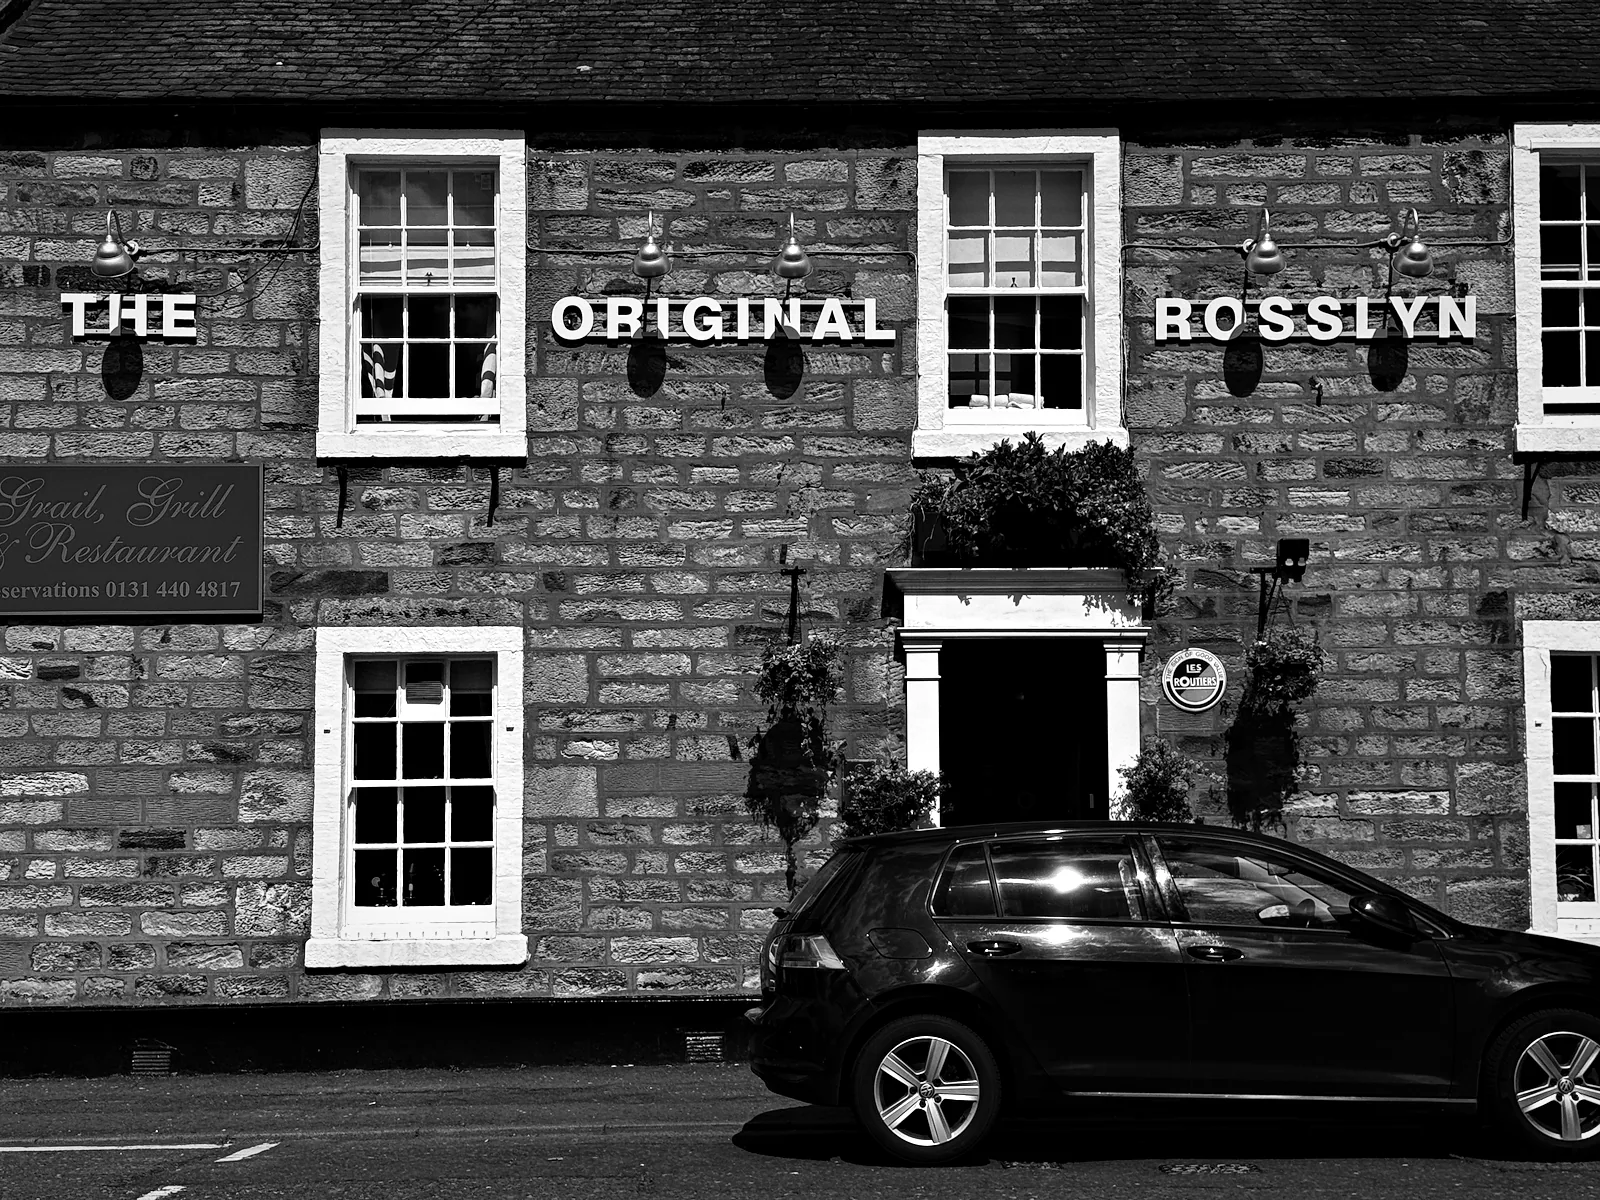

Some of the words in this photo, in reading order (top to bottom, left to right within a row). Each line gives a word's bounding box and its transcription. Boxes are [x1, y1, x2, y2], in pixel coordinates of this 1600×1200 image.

[60, 293, 197, 337] THE
[551, 296, 897, 341] ORIGINAL
[1155, 295, 1477, 341] ROSSLYN
[0, 476, 107, 528] Grail,
[126, 476, 235, 527] Grill
[25, 521, 244, 564] Restaurant
[0, 581, 100, 598] servations
[105, 581, 149, 598] 0131
[156, 581, 190, 598] 440
[195, 581, 241, 598] 4817
[1195, 651, 1213, 662] GOOD
[1185, 663, 1202, 674] LES
[1173, 676, 1217, 688] ROUTIERS
